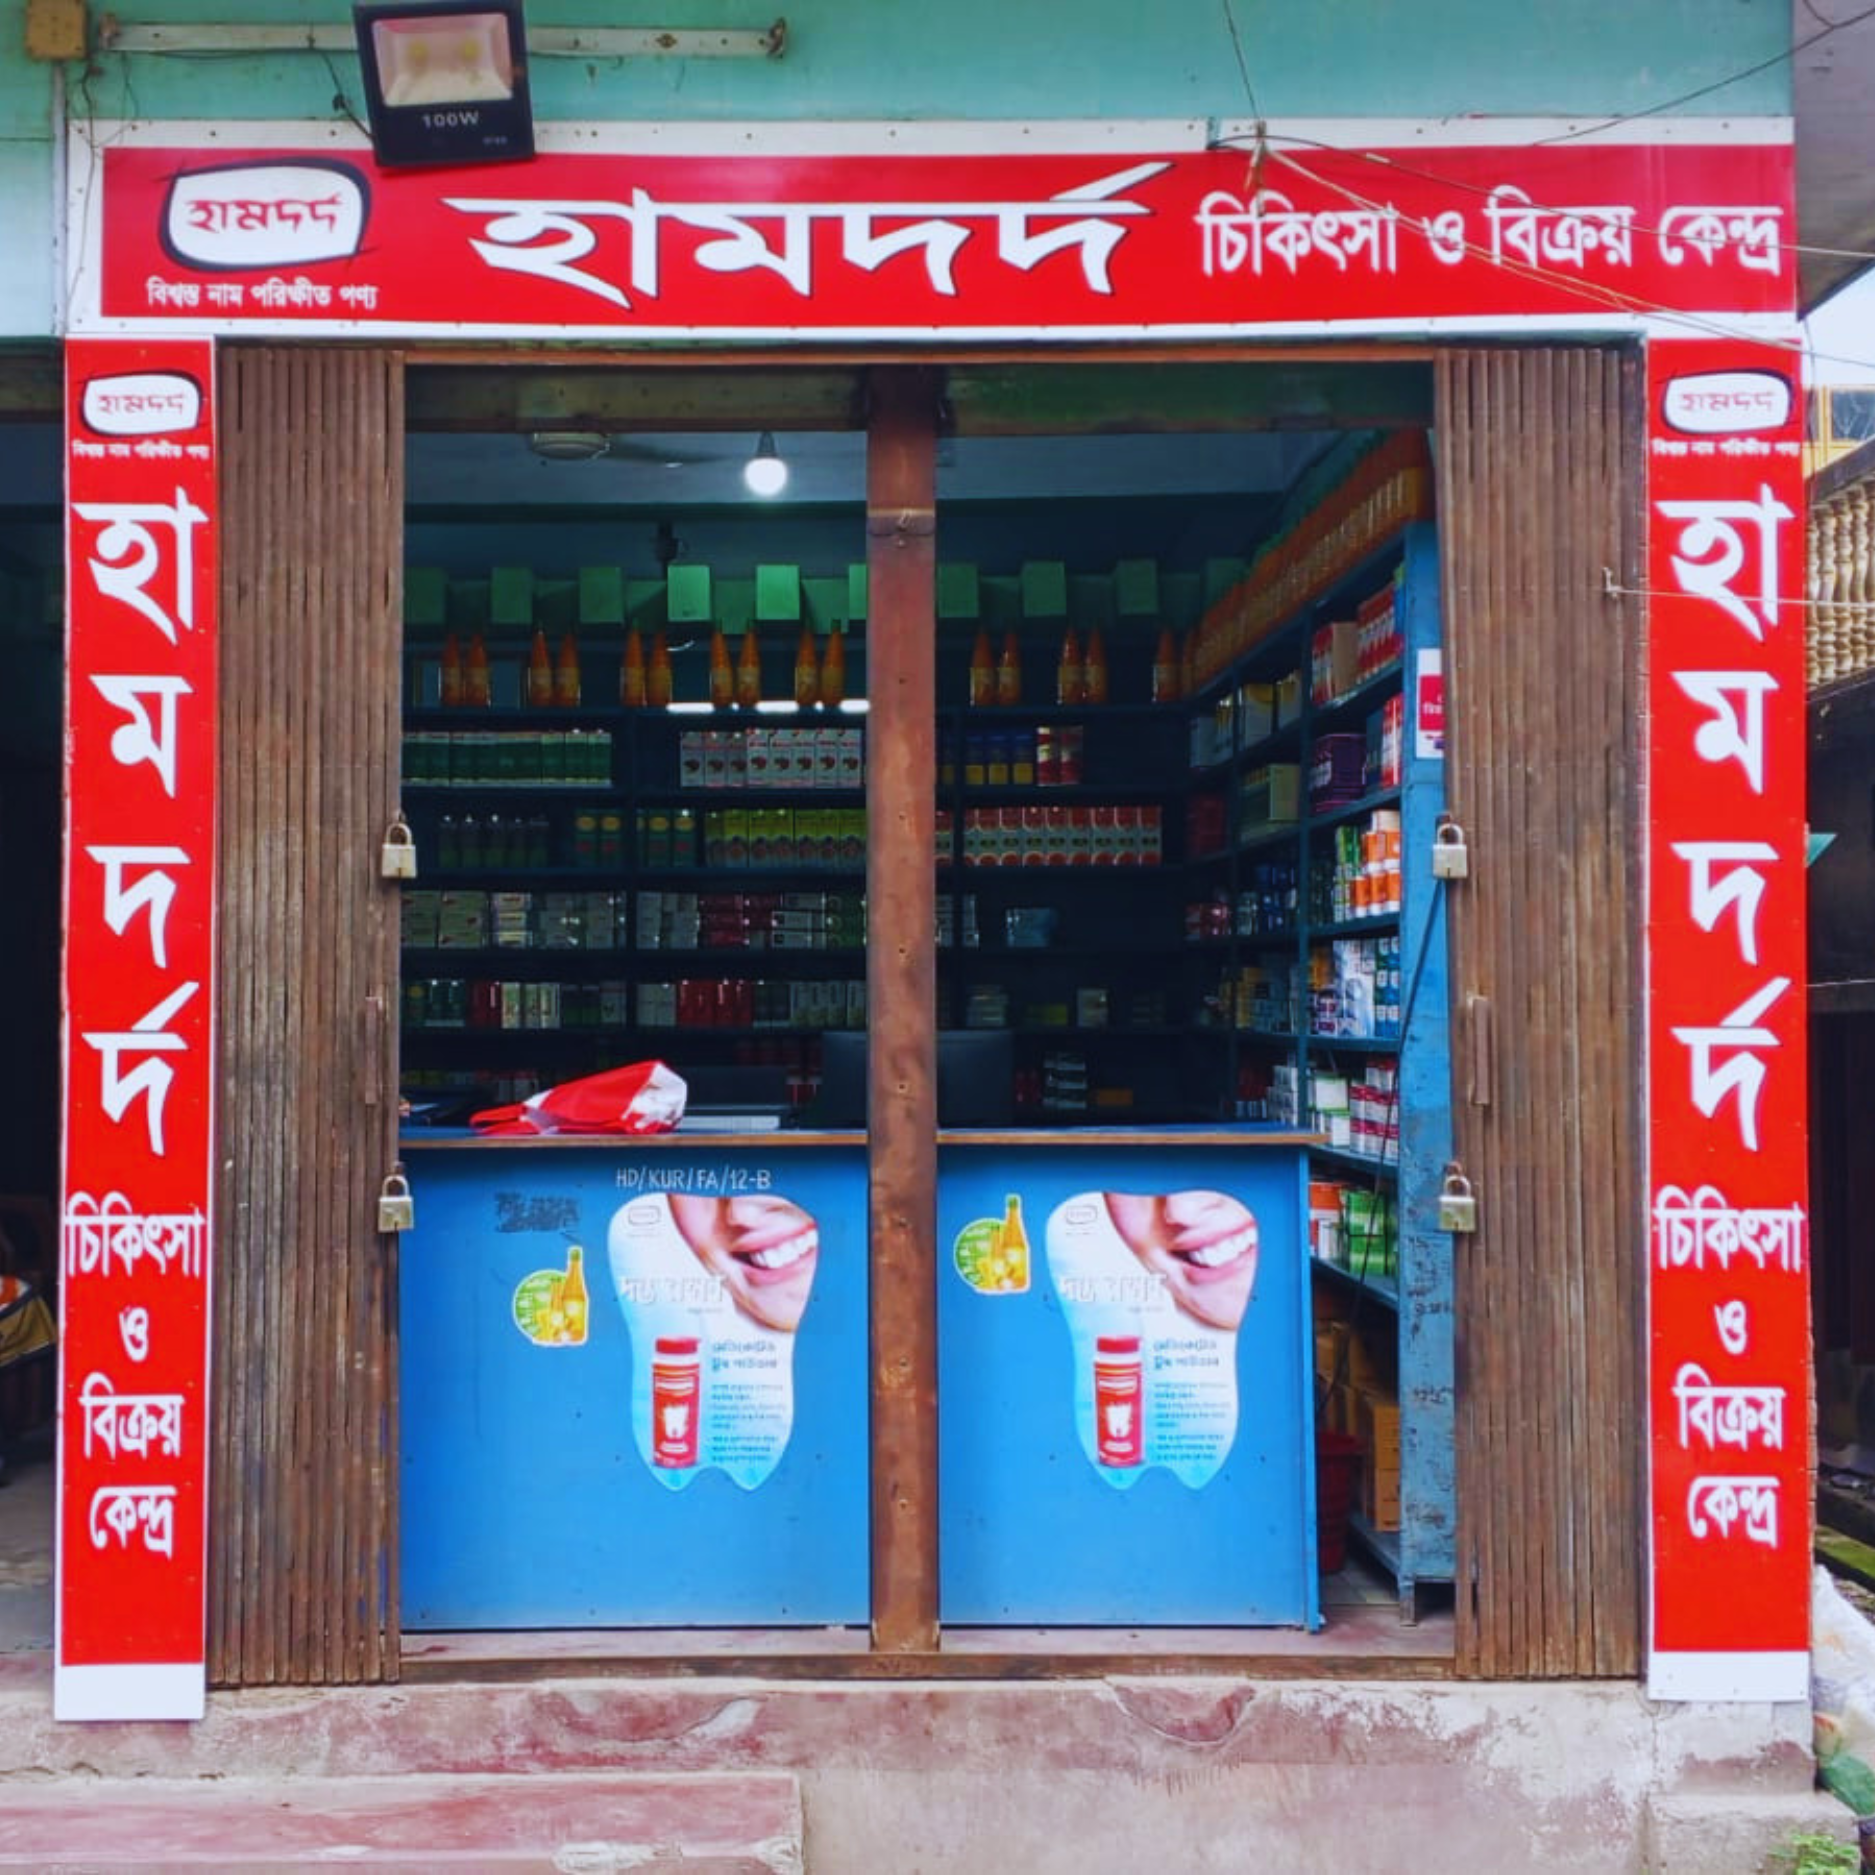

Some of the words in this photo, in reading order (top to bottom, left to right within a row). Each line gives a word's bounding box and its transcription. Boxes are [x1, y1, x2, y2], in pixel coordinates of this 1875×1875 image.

[421, 110, 480, 130] 100W
[186, 193, 342, 234] হামদর্দ
[442, 162, 1175, 310] হামদর্দ
[1195, 191, 1399, 276] চিকিৎসা
[1421, 211, 1466, 265] ও
[1484, 185, 1636, 268] বিক্রয়
[1658, 206, 1784, 276] কেন্দ্র
[146, 276, 200, 308] বিশ্বস্ত
[206, 282, 244, 308] নাম
[338, 283, 379, 310] পণ্য
[615, 1164, 773, 1195] HD/KUR/FA/12-B
[64, 1191, 206, 1278] চিকিৎসা
[1652, 1184, 1807, 1274] চিকিৎসা
[119, 1306, 150, 1363] ও
[1714, 1299, 1748, 1355] ও
[79, 1371, 186, 1460] বিক্রয়
[1671, 1362, 1787, 1452] বিক্রয়
[89, 1485, 177, 1560] কেন্দ্র
[1686, 1475, 1780, 1549] কেন্দ্র
